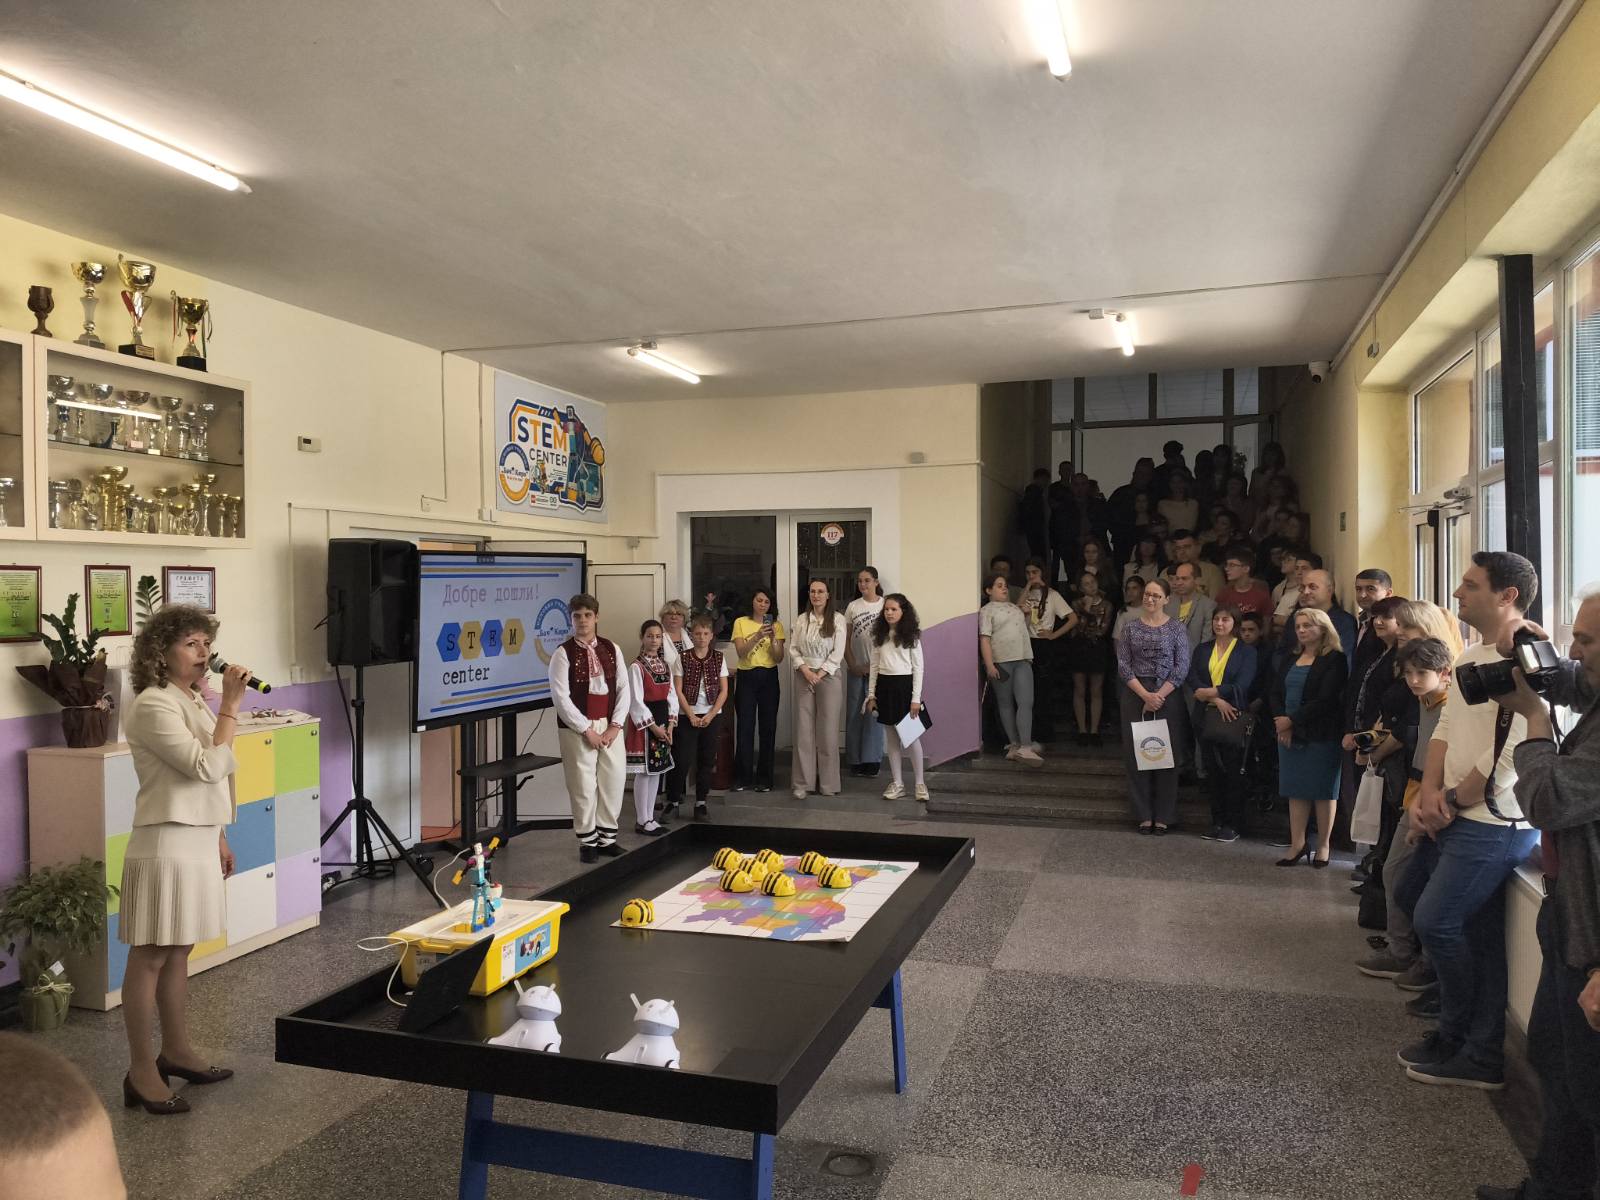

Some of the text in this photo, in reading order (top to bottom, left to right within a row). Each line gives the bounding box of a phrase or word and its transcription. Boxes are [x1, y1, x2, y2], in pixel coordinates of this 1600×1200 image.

[517, 416, 568, 452] STEM
[529, 448, 567, 467] CENTER
[443, 583, 540, 608] Добре дошли!
[446, 628, 517, 652] STEM
[442, 664, 490, 685] center
